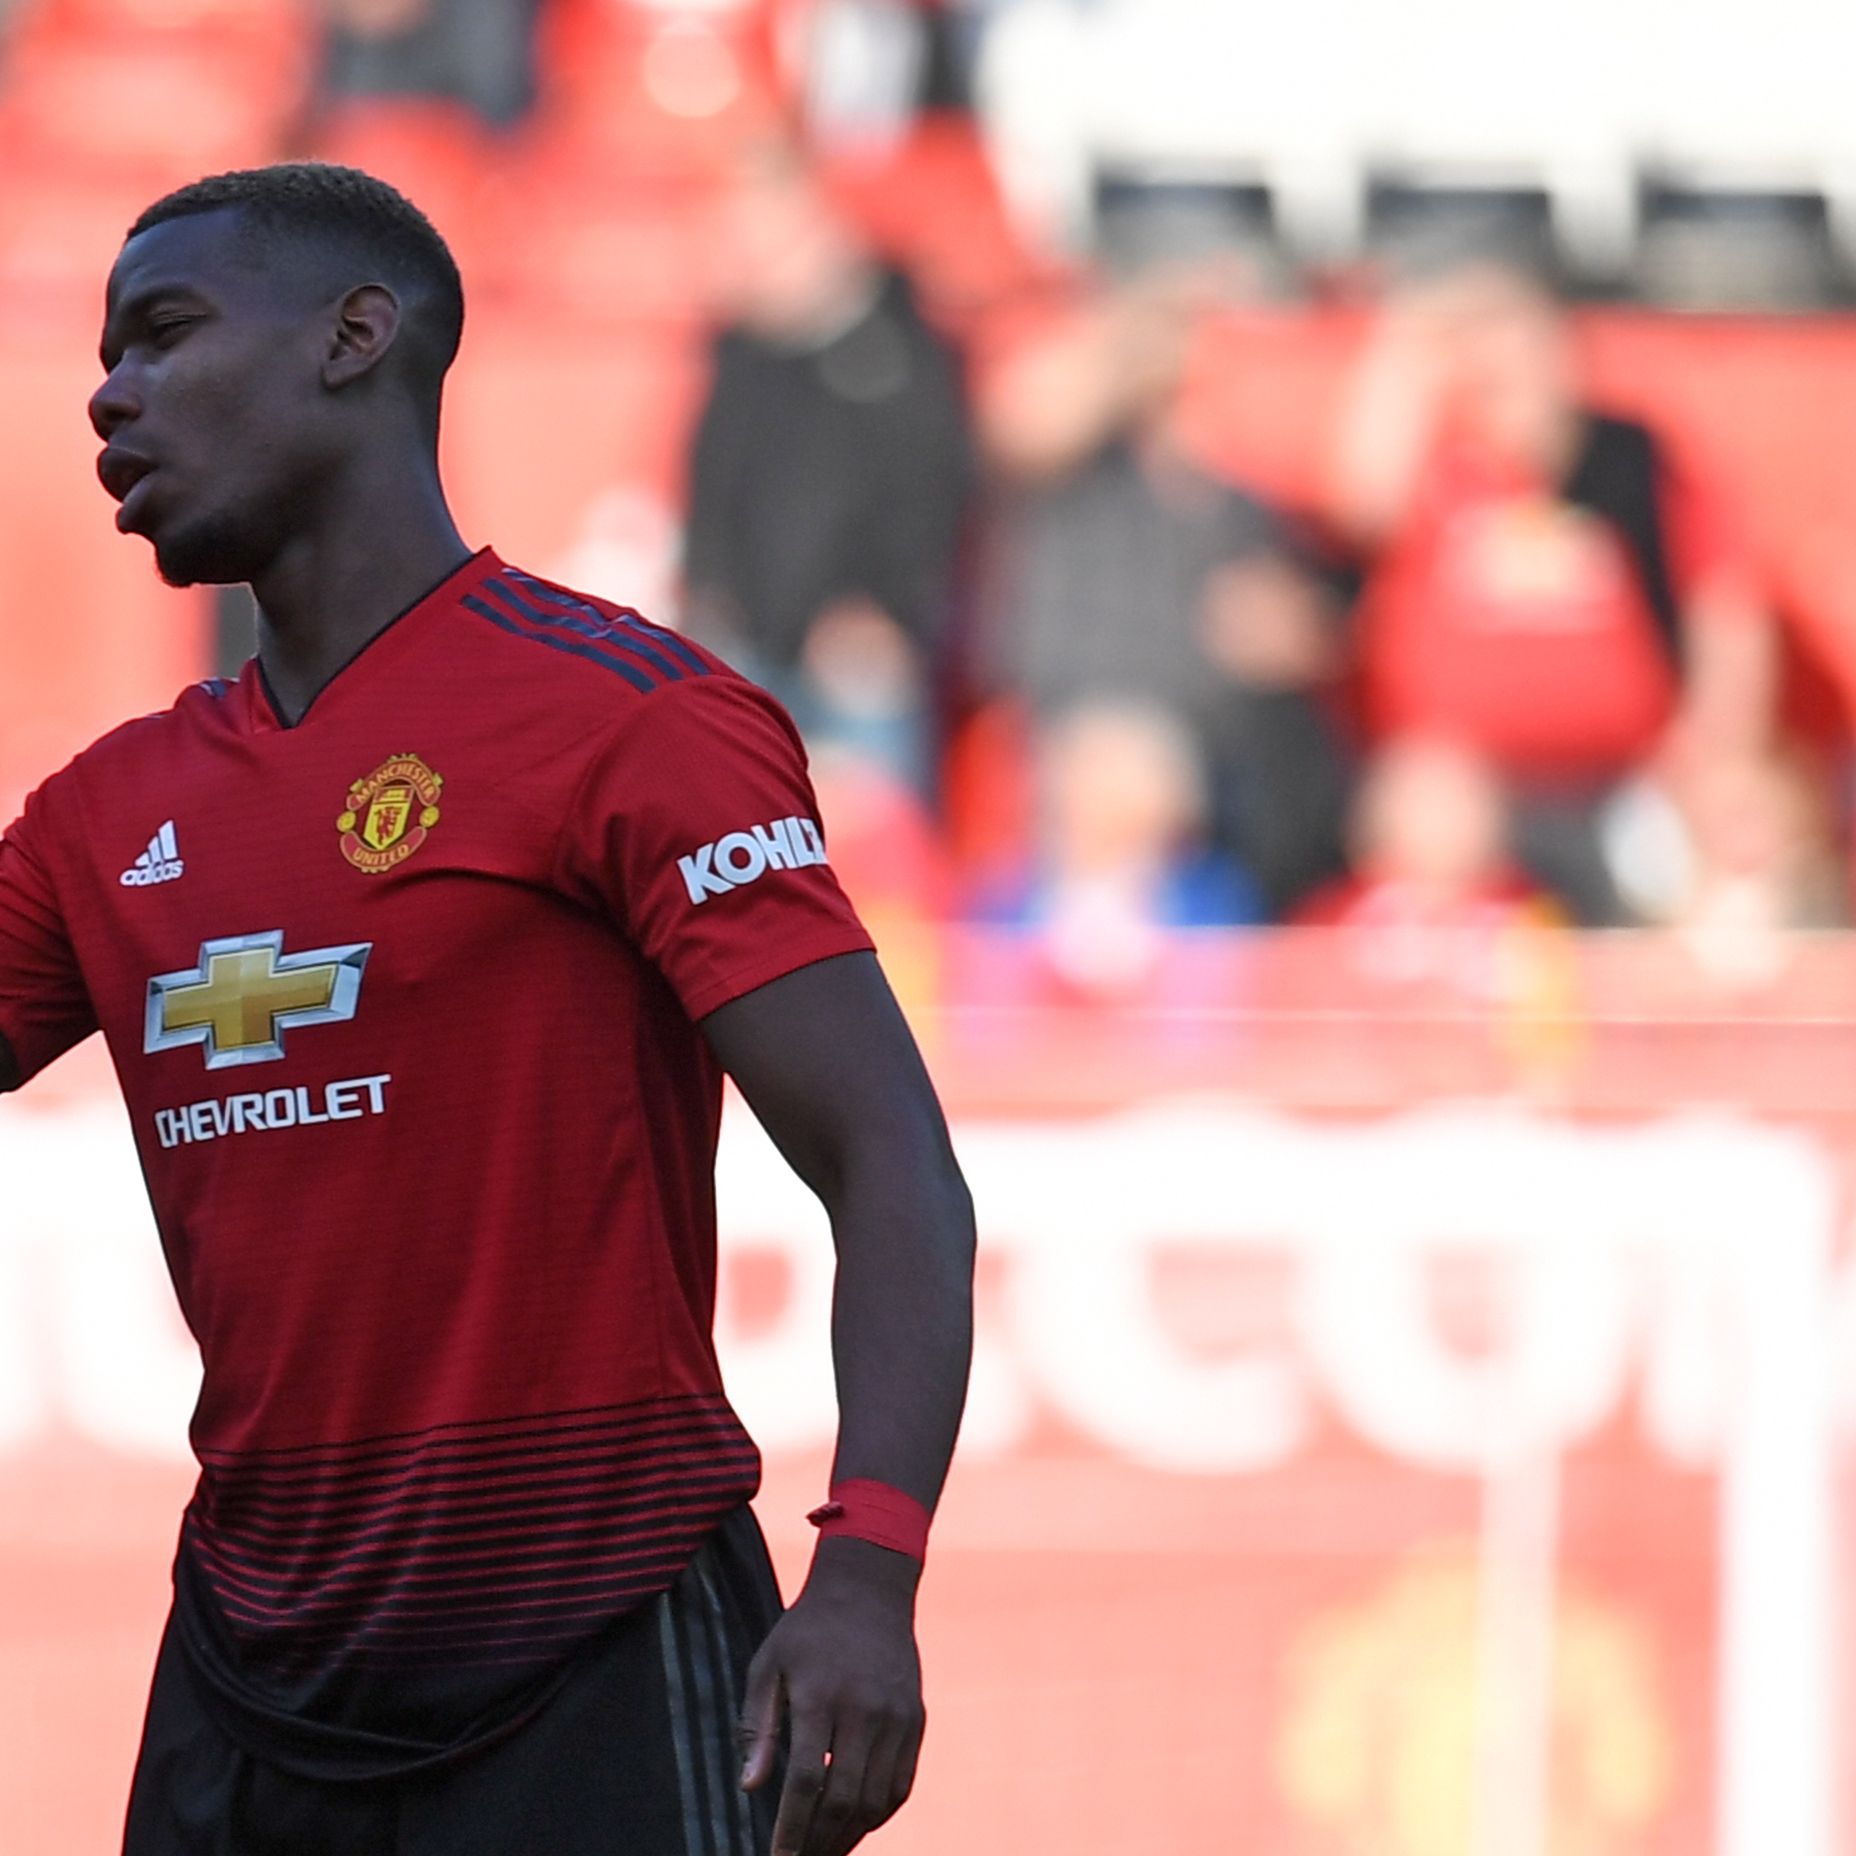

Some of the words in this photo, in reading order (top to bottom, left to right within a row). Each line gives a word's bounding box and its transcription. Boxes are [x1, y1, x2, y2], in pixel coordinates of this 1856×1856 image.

[355, 763, 436, 801] MANCHESTER
[352, 843, 410, 866] UNITED
[119, 859, 185, 887] adidas
[154, 1073, 392, 1148] CHEVROLET
